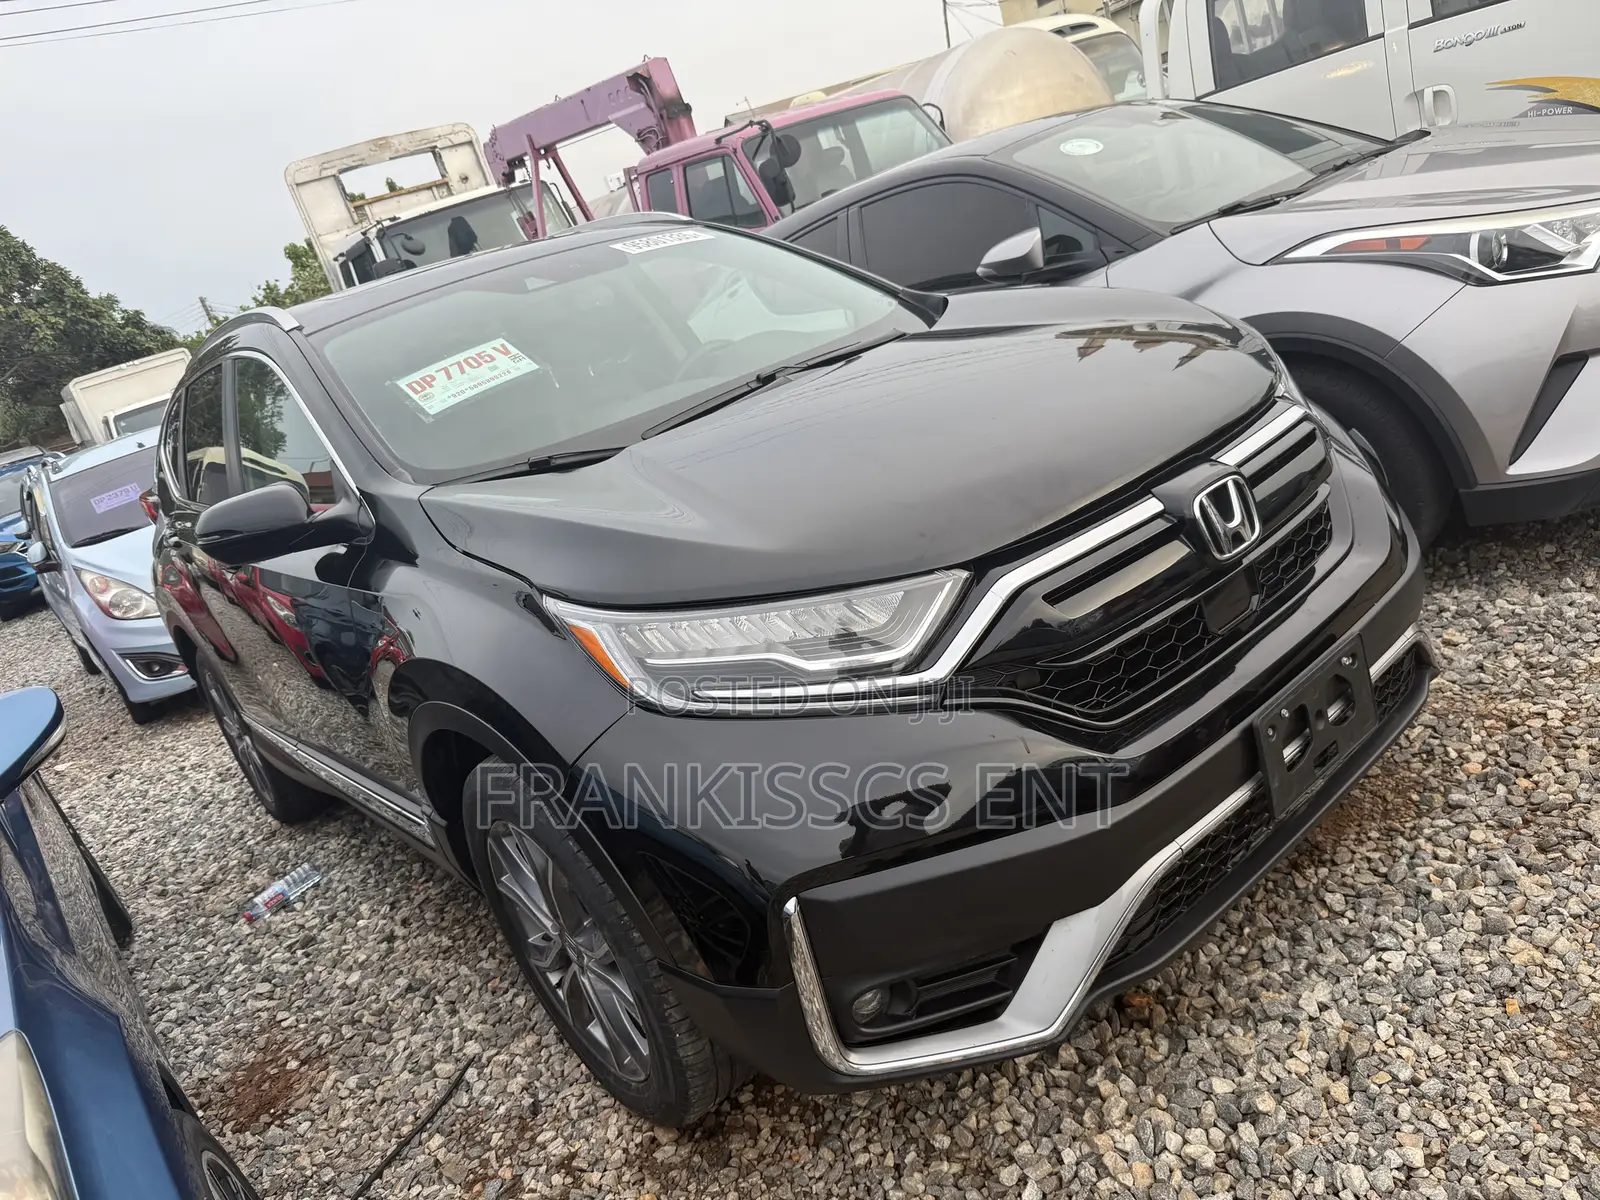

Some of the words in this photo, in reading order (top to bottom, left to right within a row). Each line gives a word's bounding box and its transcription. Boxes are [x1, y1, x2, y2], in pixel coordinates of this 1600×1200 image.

[1527, 107, 1573, 118] HI-POWER
[406, 374, 437, 396] DP
[435, 350, 497, 381] 7705
[491, 343, 512, 357] V
